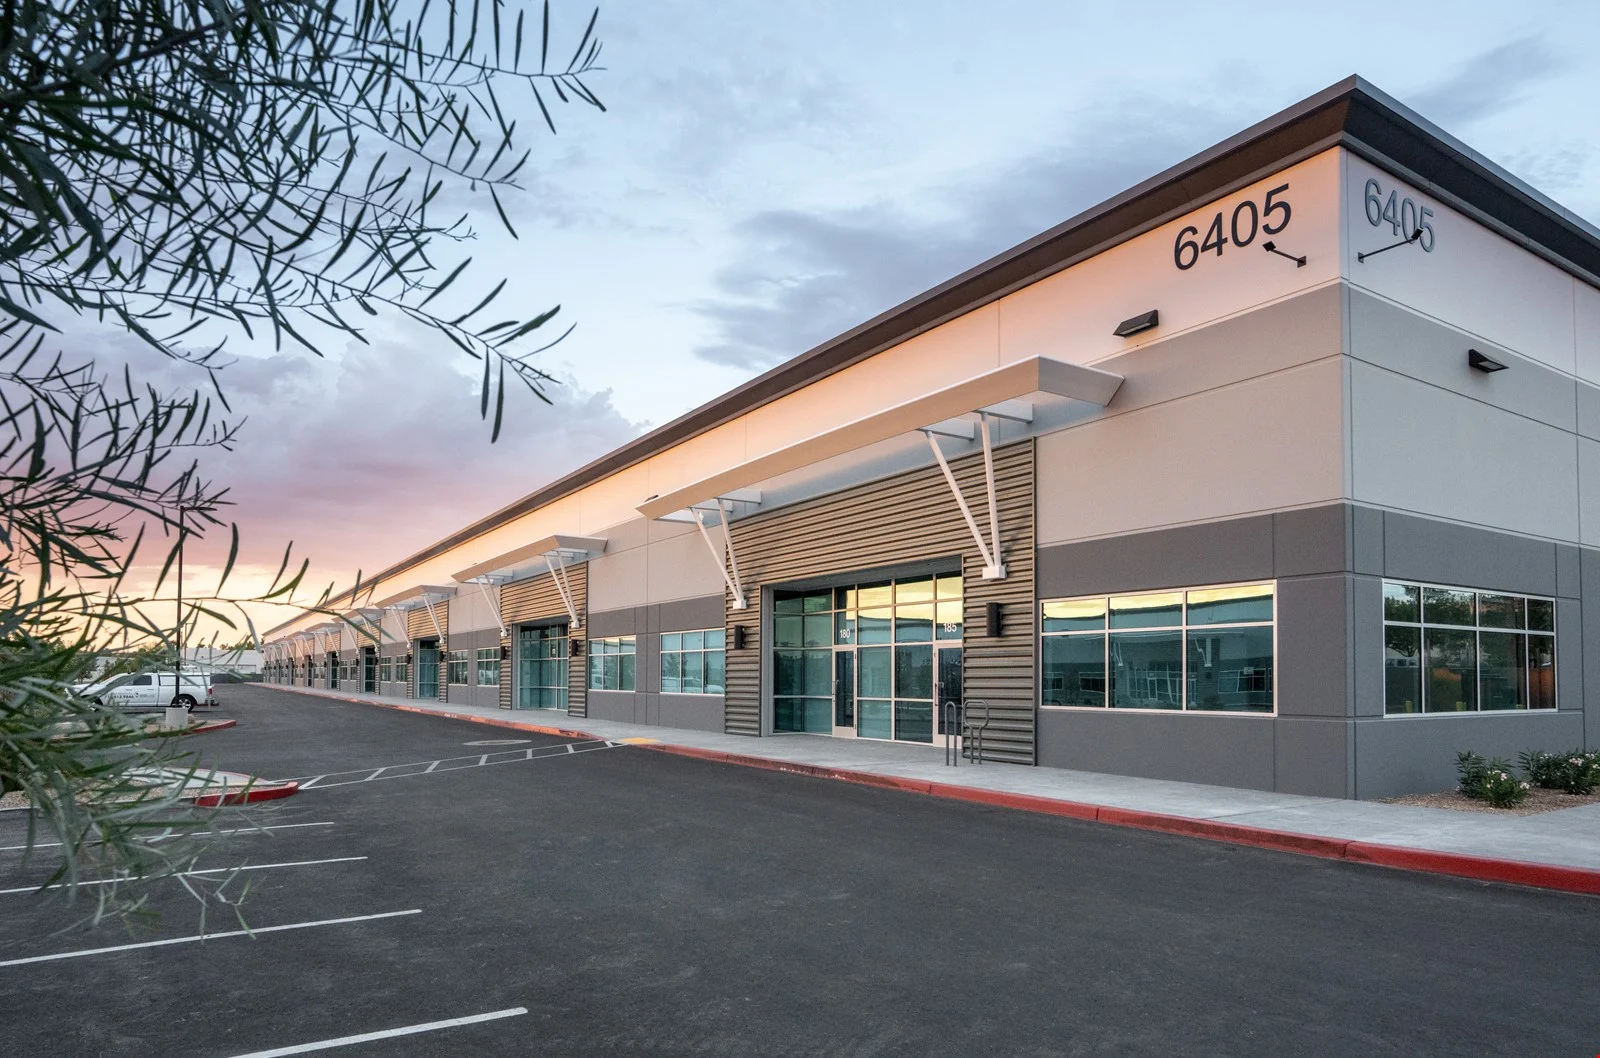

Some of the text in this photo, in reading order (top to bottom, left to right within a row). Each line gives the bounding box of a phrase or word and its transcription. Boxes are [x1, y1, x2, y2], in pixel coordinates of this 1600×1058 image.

[1174, 183, 1292, 270] 6405
[1364, 178, 1435, 253] 6405
[840, 629, 850, 638] 180
[943, 622, 957, 632] 185
